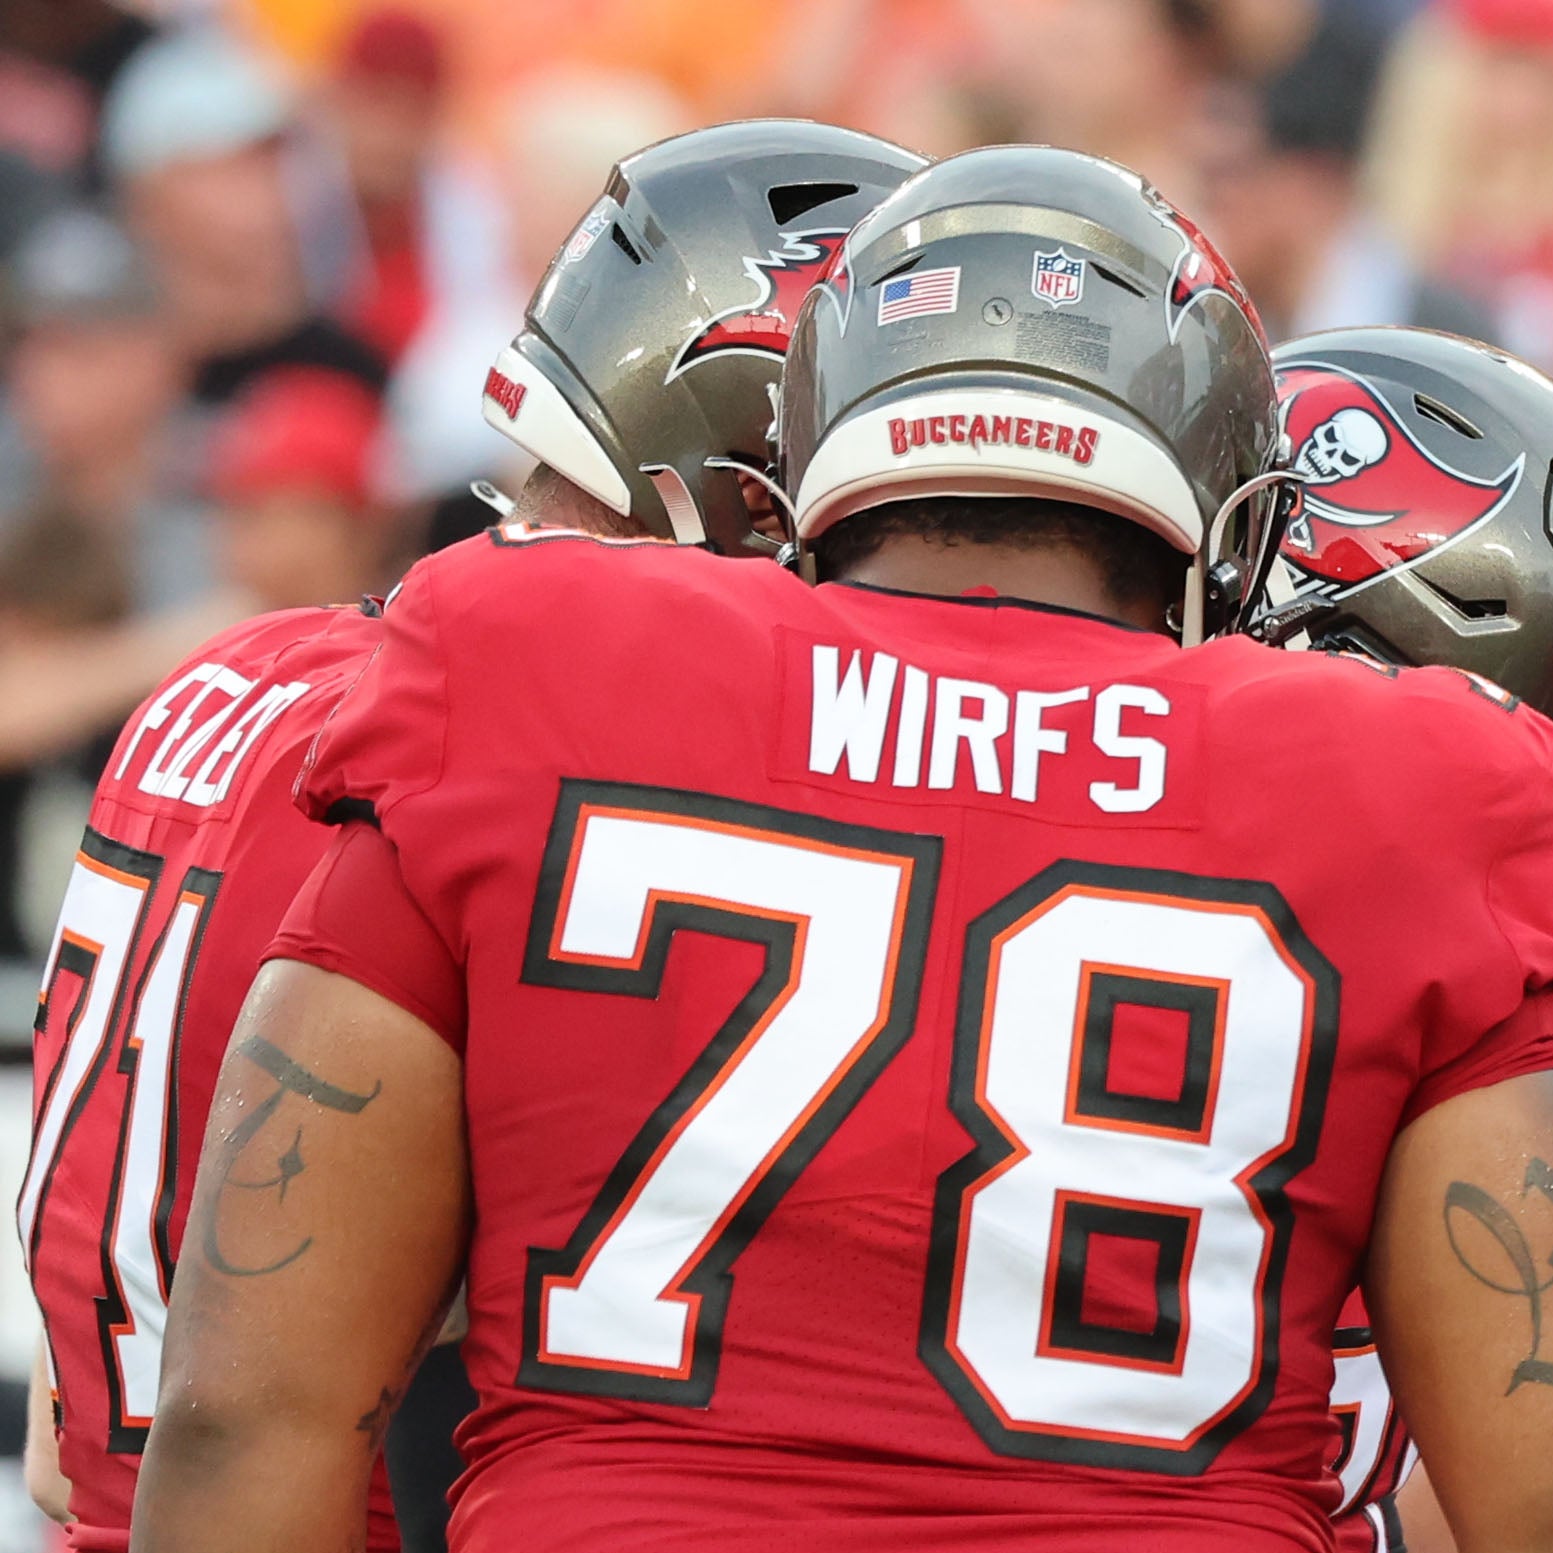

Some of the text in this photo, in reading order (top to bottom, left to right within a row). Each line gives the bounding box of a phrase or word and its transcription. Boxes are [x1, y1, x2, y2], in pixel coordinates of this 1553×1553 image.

[1038, 272, 1076, 298] NFL
[888, 414, 1100, 465] BUCCANEERS
[809, 645, 1171, 812] WIRFS
[18, 824, 224, 1455] 71
[515, 777, 1342, 1475] 78
